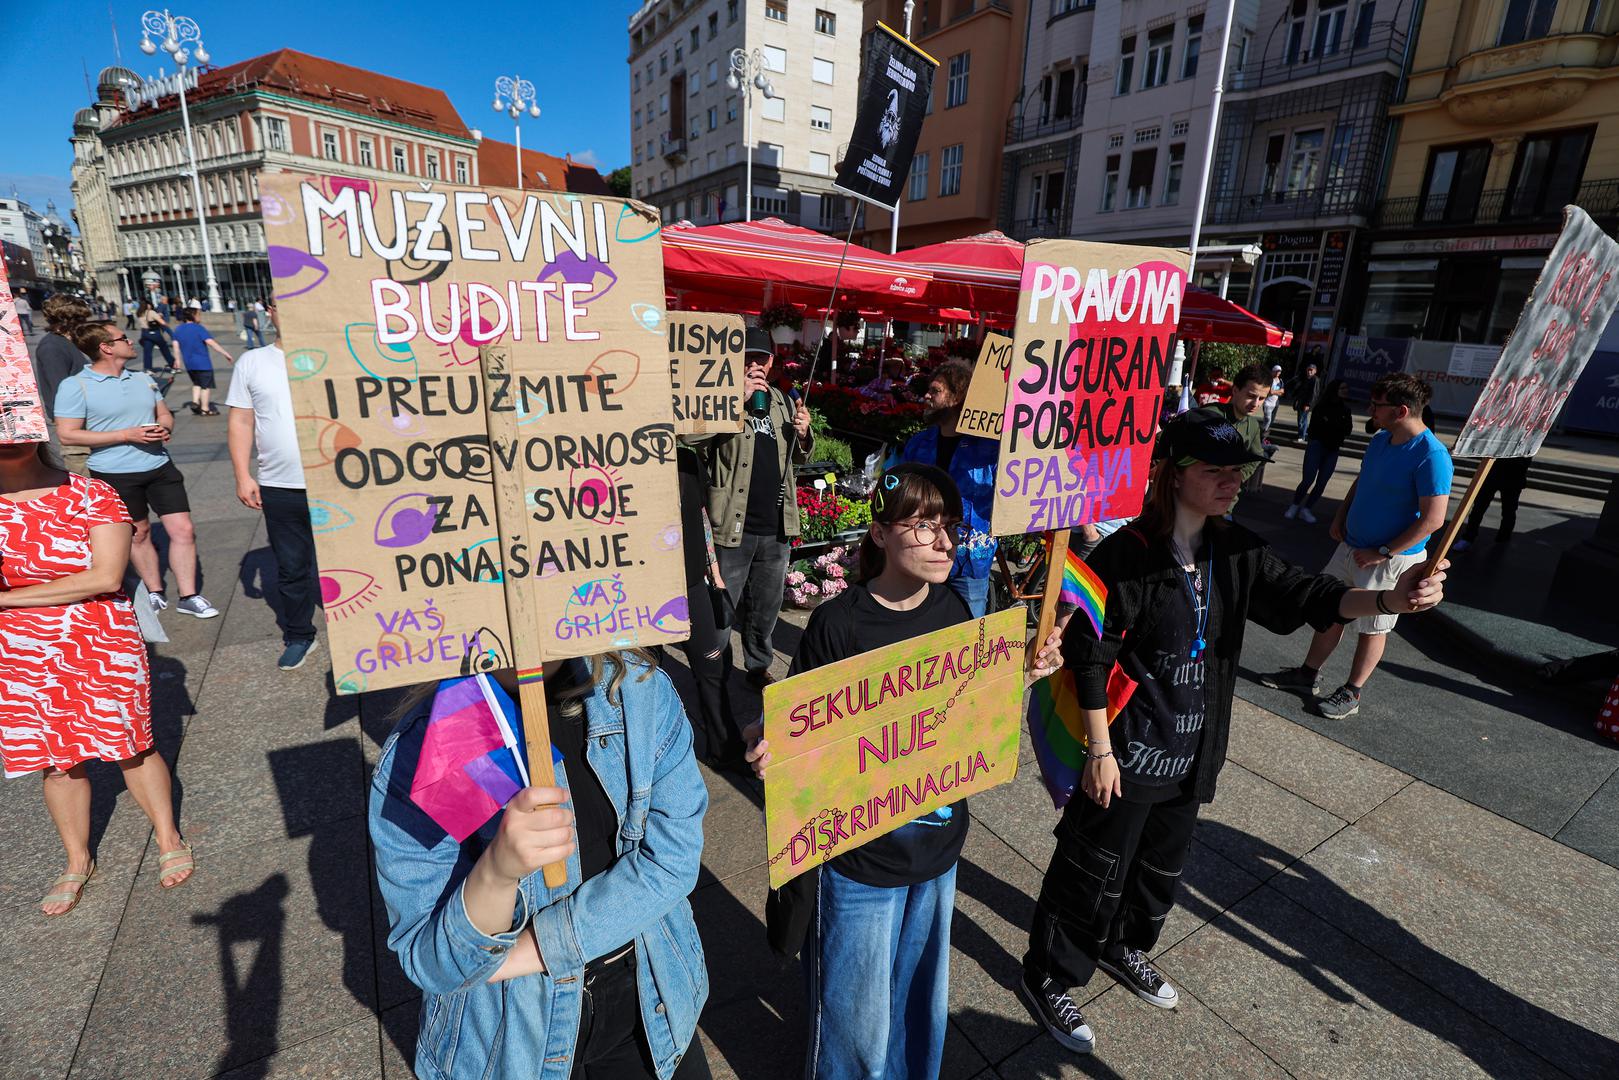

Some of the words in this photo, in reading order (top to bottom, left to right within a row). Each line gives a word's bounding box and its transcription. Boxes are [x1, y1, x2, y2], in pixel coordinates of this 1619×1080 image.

[300, 182, 610, 263] MUŽEVNI
[1278, 234, 1314, 246] Dogma
[370, 277, 601, 345] BUDITE
[1028, 265, 1141, 325] PRAVO
[1140, 271, 1181, 324] NA
[695, 358, 735, 388] ZA
[1018, 333, 1176, 395] SIGURAN
[325, 379, 339, 419] I
[357, 371, 623, 417] PREUZMITE
[1009, 390, 1161, 453] POBAČAJ
[334, 432, 669, 489] ODGOVORNOST
[1000, 444, 1133, 498] SPAŠAVA
[426, 494, 490, 534] ZA
[532, 484, 638, 522] SVOJE
[395, 533, 646, 591] PONAŠANJE.
[573, 573, 627, 608] VAŠ
[375, 599, 444, 633] VAŠ
[555, 605, 653, 640] GRIJEH
[355, 630, 485, 673] GRIJEH
[790, 636, 1011, 737] SEKULARIZACIJA
[858, 708, 937, 774] NIJE
[790, 751, 996, 866] DISKRIMINACIJA.
